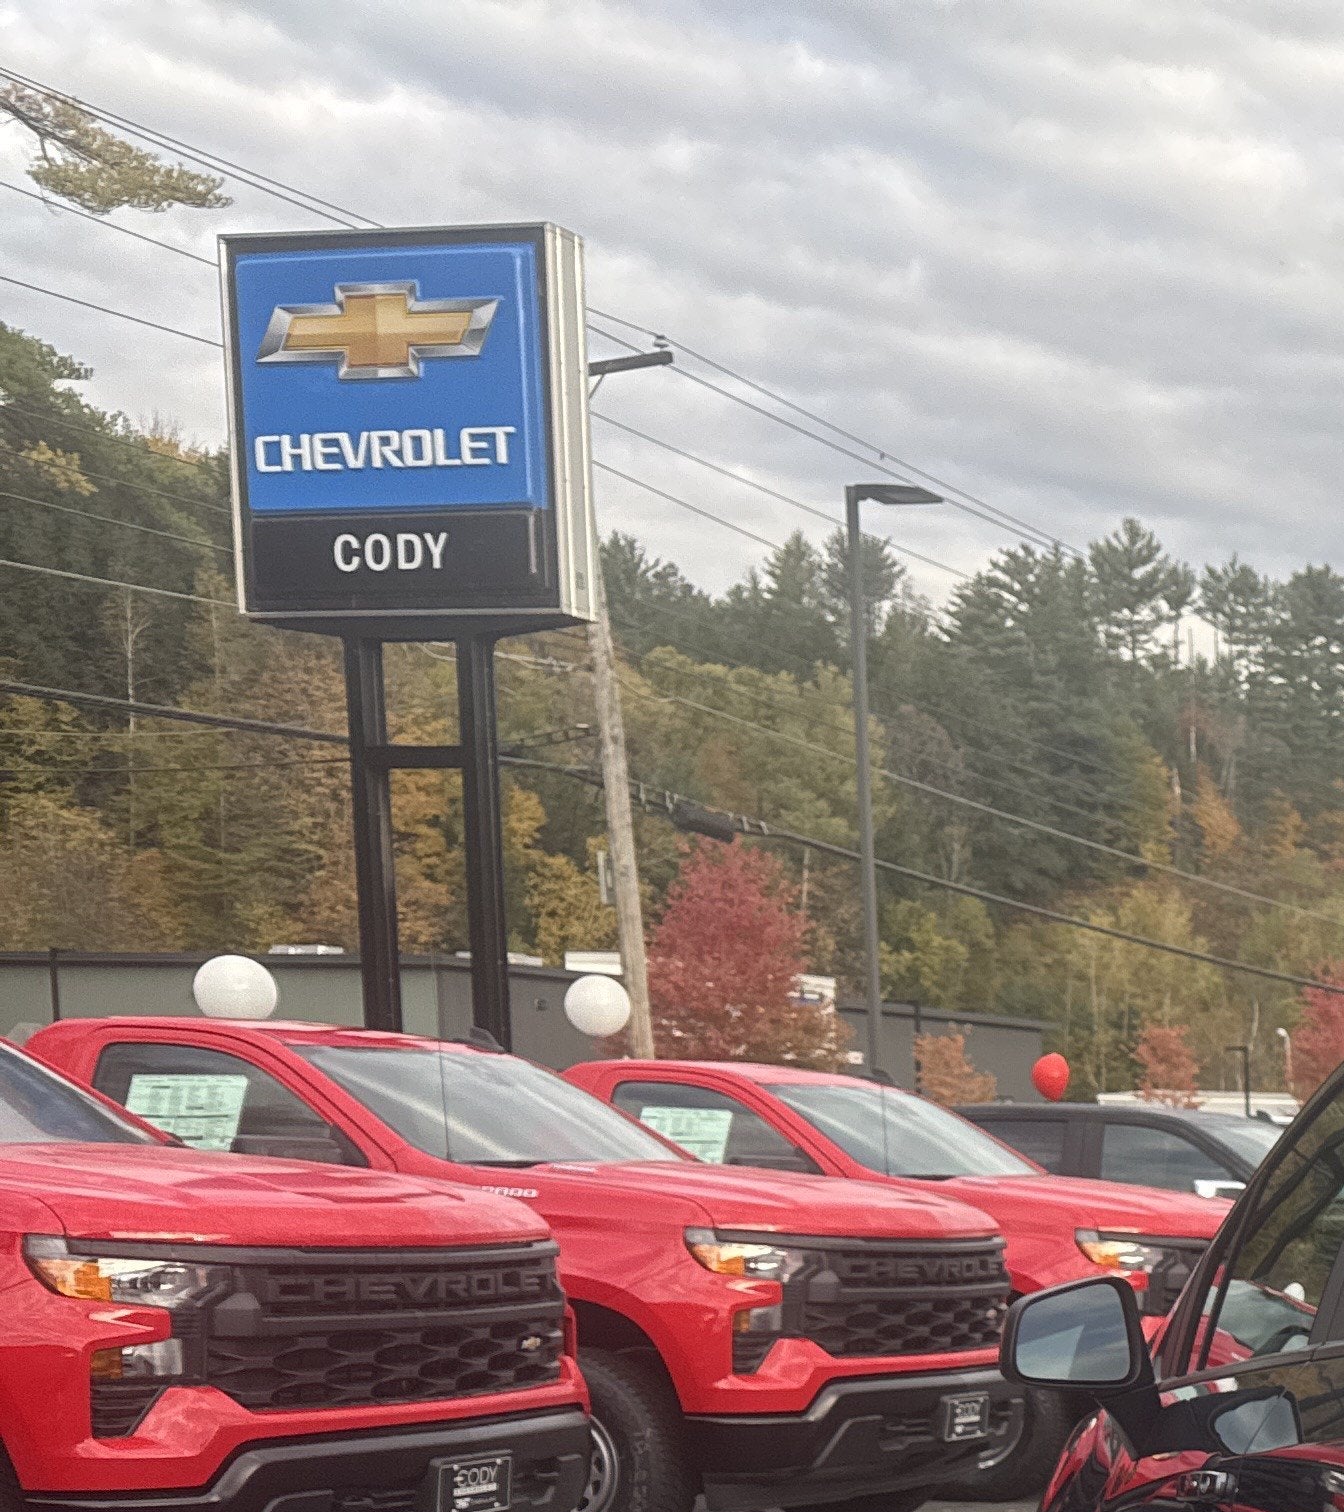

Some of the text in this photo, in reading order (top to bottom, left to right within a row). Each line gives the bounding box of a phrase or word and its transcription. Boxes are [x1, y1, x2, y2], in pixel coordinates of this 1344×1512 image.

[254, 427, 516, 473] CHEVROLET
[333, 531, 448, 573] CODY
[456, 1465, 498, 1487] CODY
